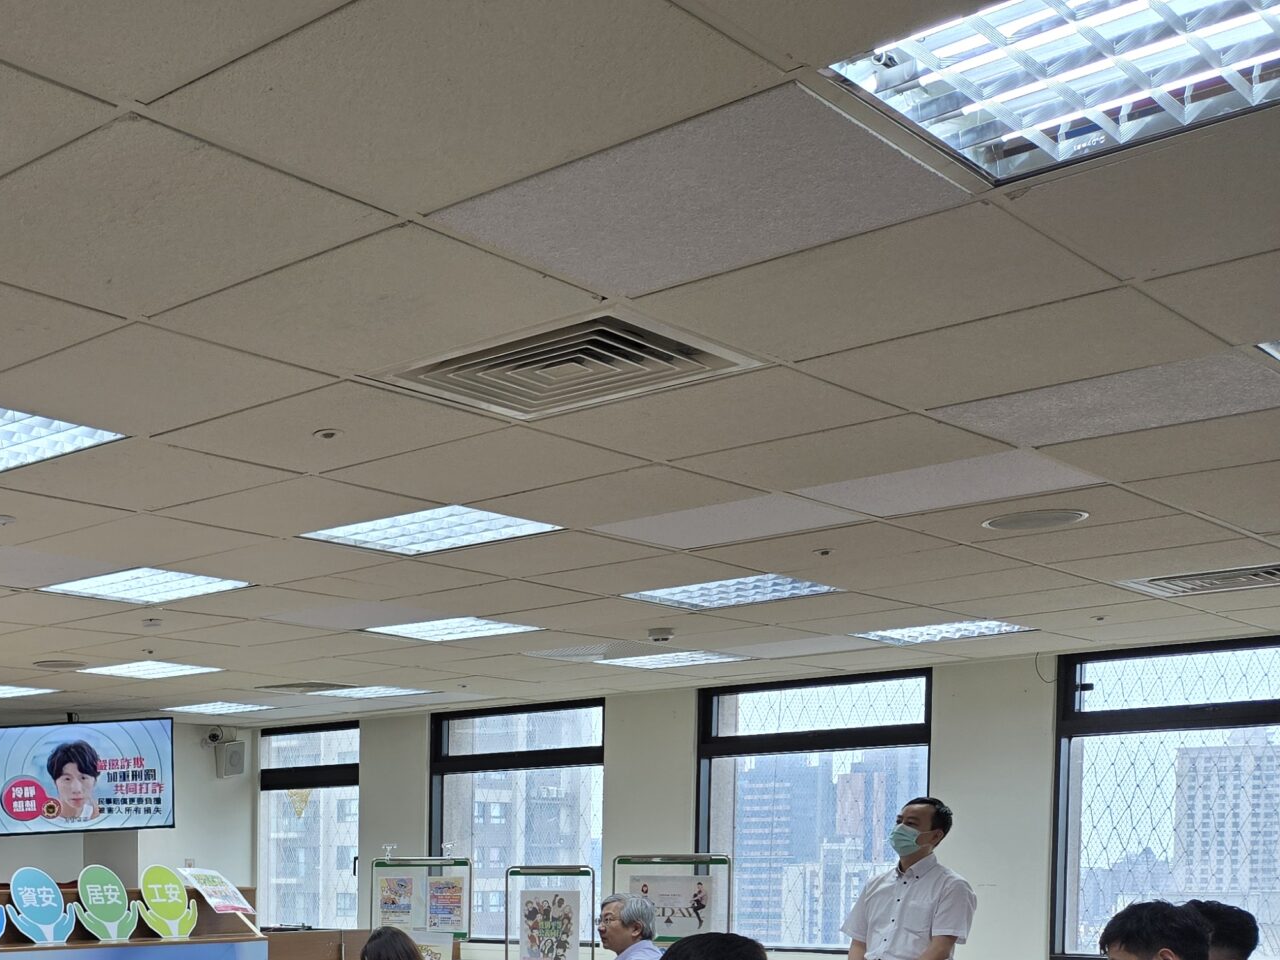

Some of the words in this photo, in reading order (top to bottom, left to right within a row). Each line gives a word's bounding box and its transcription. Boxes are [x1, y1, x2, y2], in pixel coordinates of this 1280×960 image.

[113, 783, 165, 794] 共同打詐
[18, 886, 58, 908] 資安
[85, 884, 122, 905] 居安
[147, 883, 182, 903] 工安
